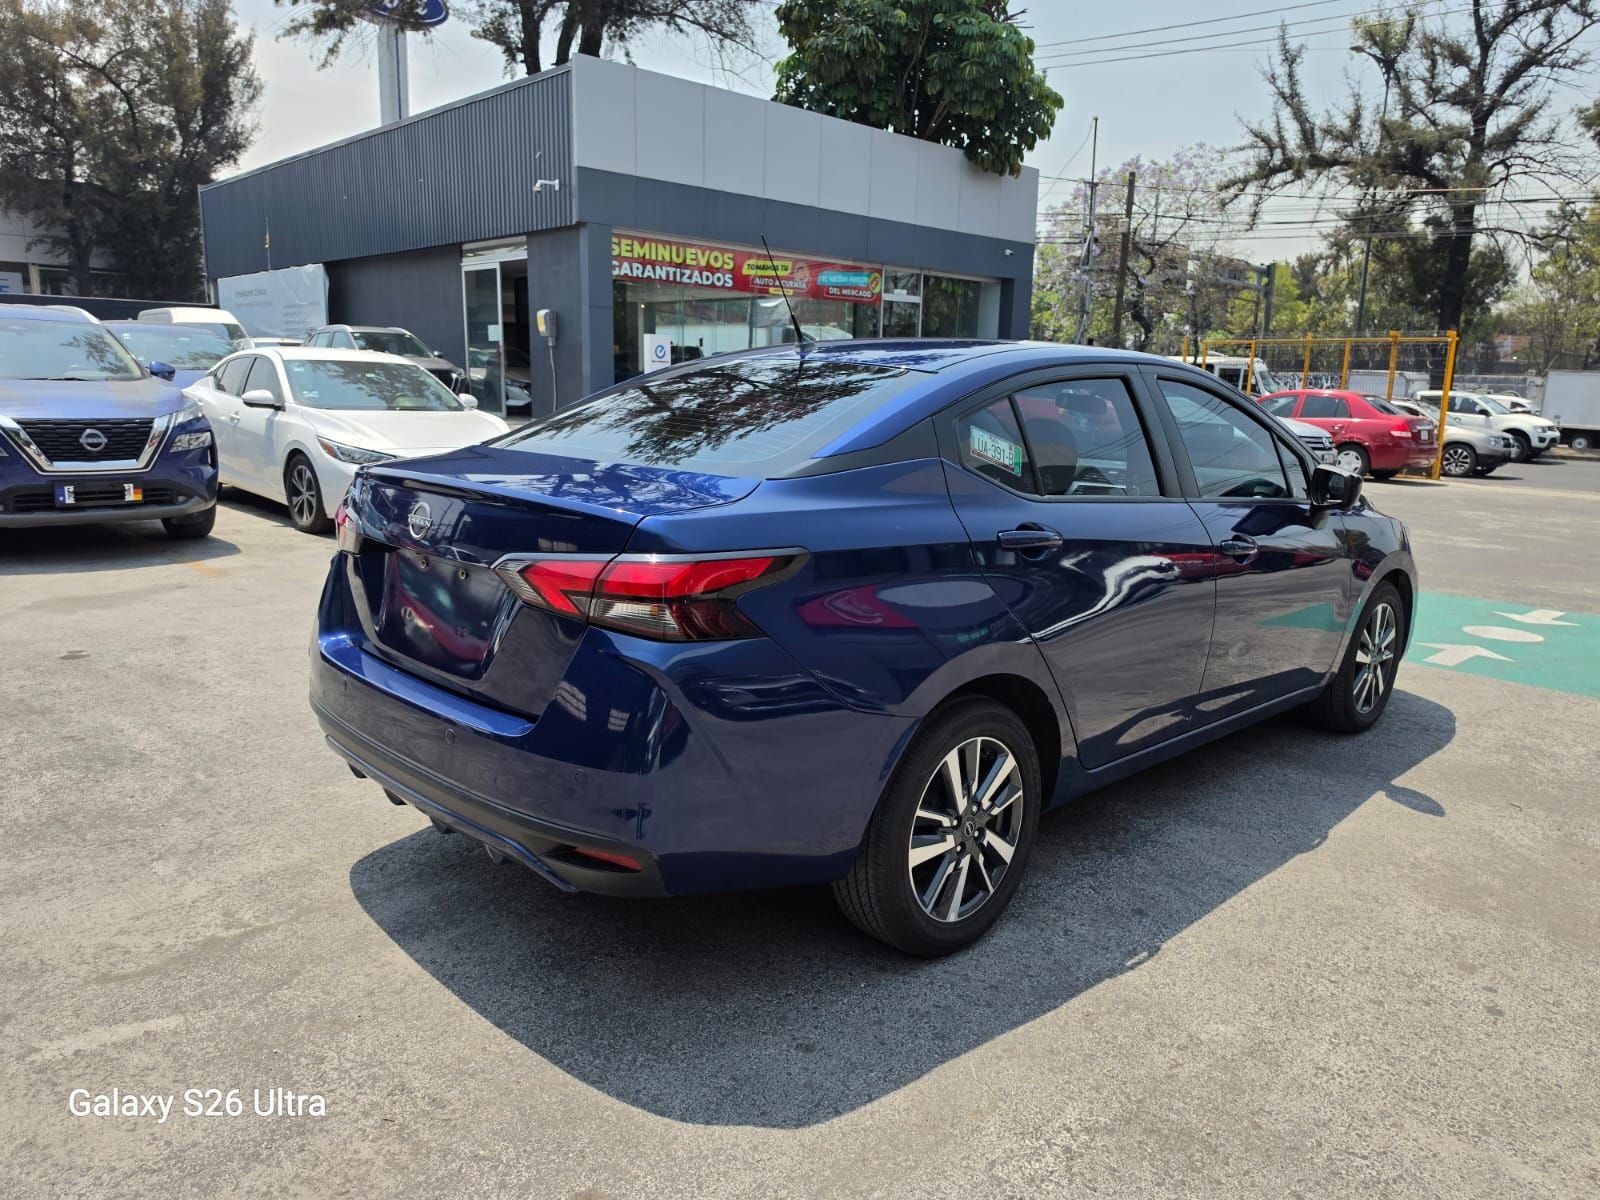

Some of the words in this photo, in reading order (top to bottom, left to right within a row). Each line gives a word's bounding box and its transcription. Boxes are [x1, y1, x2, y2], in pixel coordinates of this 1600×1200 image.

[611, 238, 734, 270] SEMINUEVOS
[754, 277, 774, 286] AUTO
[781, 280, 807, 289] CUENTA
[829, 286, 841, 295] DEL
[841, 288, 872, 298] MERCADO
